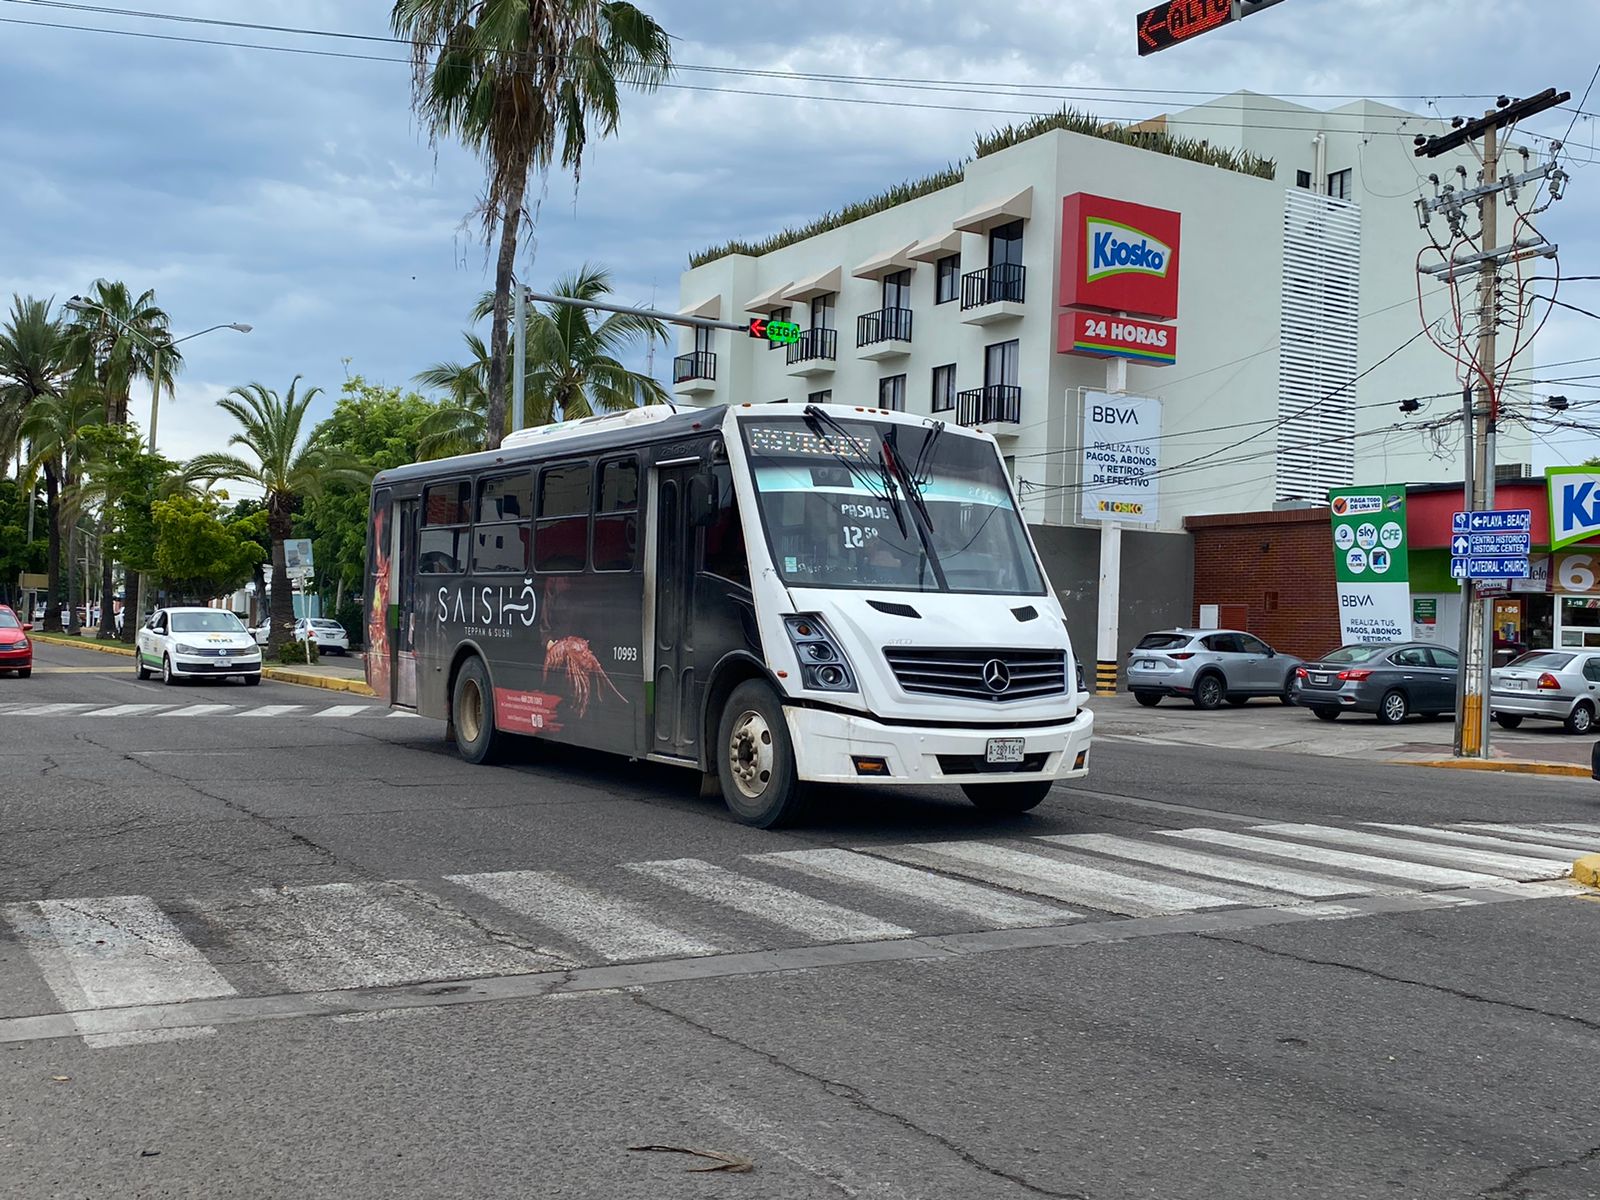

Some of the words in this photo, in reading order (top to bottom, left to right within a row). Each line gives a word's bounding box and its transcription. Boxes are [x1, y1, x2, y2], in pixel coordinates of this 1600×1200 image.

[1093, 232, 1164, 270] Kiosko
[769, 325, 798, 339] SIGA
[1085, 319, 1107, 338] 24
[1111, 322, 1168, 347] HORAS
[1092, 405, 1139, 425] BBVA
[1094, 441, 1132, 454] REALIZA
[1135, 445, 1151, 456] TUS
[1086, 451, 1119, 464] PAGOS,
[1120, 455, 1157, 467] ABONOS
[1099, 464, 1105, 473] Y
[1107, 464, 1145, 476] RETIROS
[1093, 474, 1106, 483] DE
[1107, 475, 1150, 488] EFECTIVO
[841, 503, 890, 520] PASAJE
[1482, 515, 1503, 528] PLAYA
[1507, 513, 1530, 527] BEACH
[1358, 526, 1375, 539] sky
[1381, 528, 1400, 541] CFE
[1471, 535, 1495, 545] CENTRO
[1473, 544, 1500, 553] HISTORIC
[1500, 543, 1525, 553] CENTER
[1470, 560, 1500, 573] CATEDRAL
[1503, 559, 1528, 573] CHURCH
[1341, 594, 1374, 608] BBVA
[1350, 618, 1379, 627] REALIZA
[1381, 619, 1395, 627] TUS
[464, 626, 486, 637] TEPPAN
[1346, 626, 1370, 635] PAGOS,
[1371, 627, 1402, 636] ABONOS
[613, 646, 637, 661] 10993
